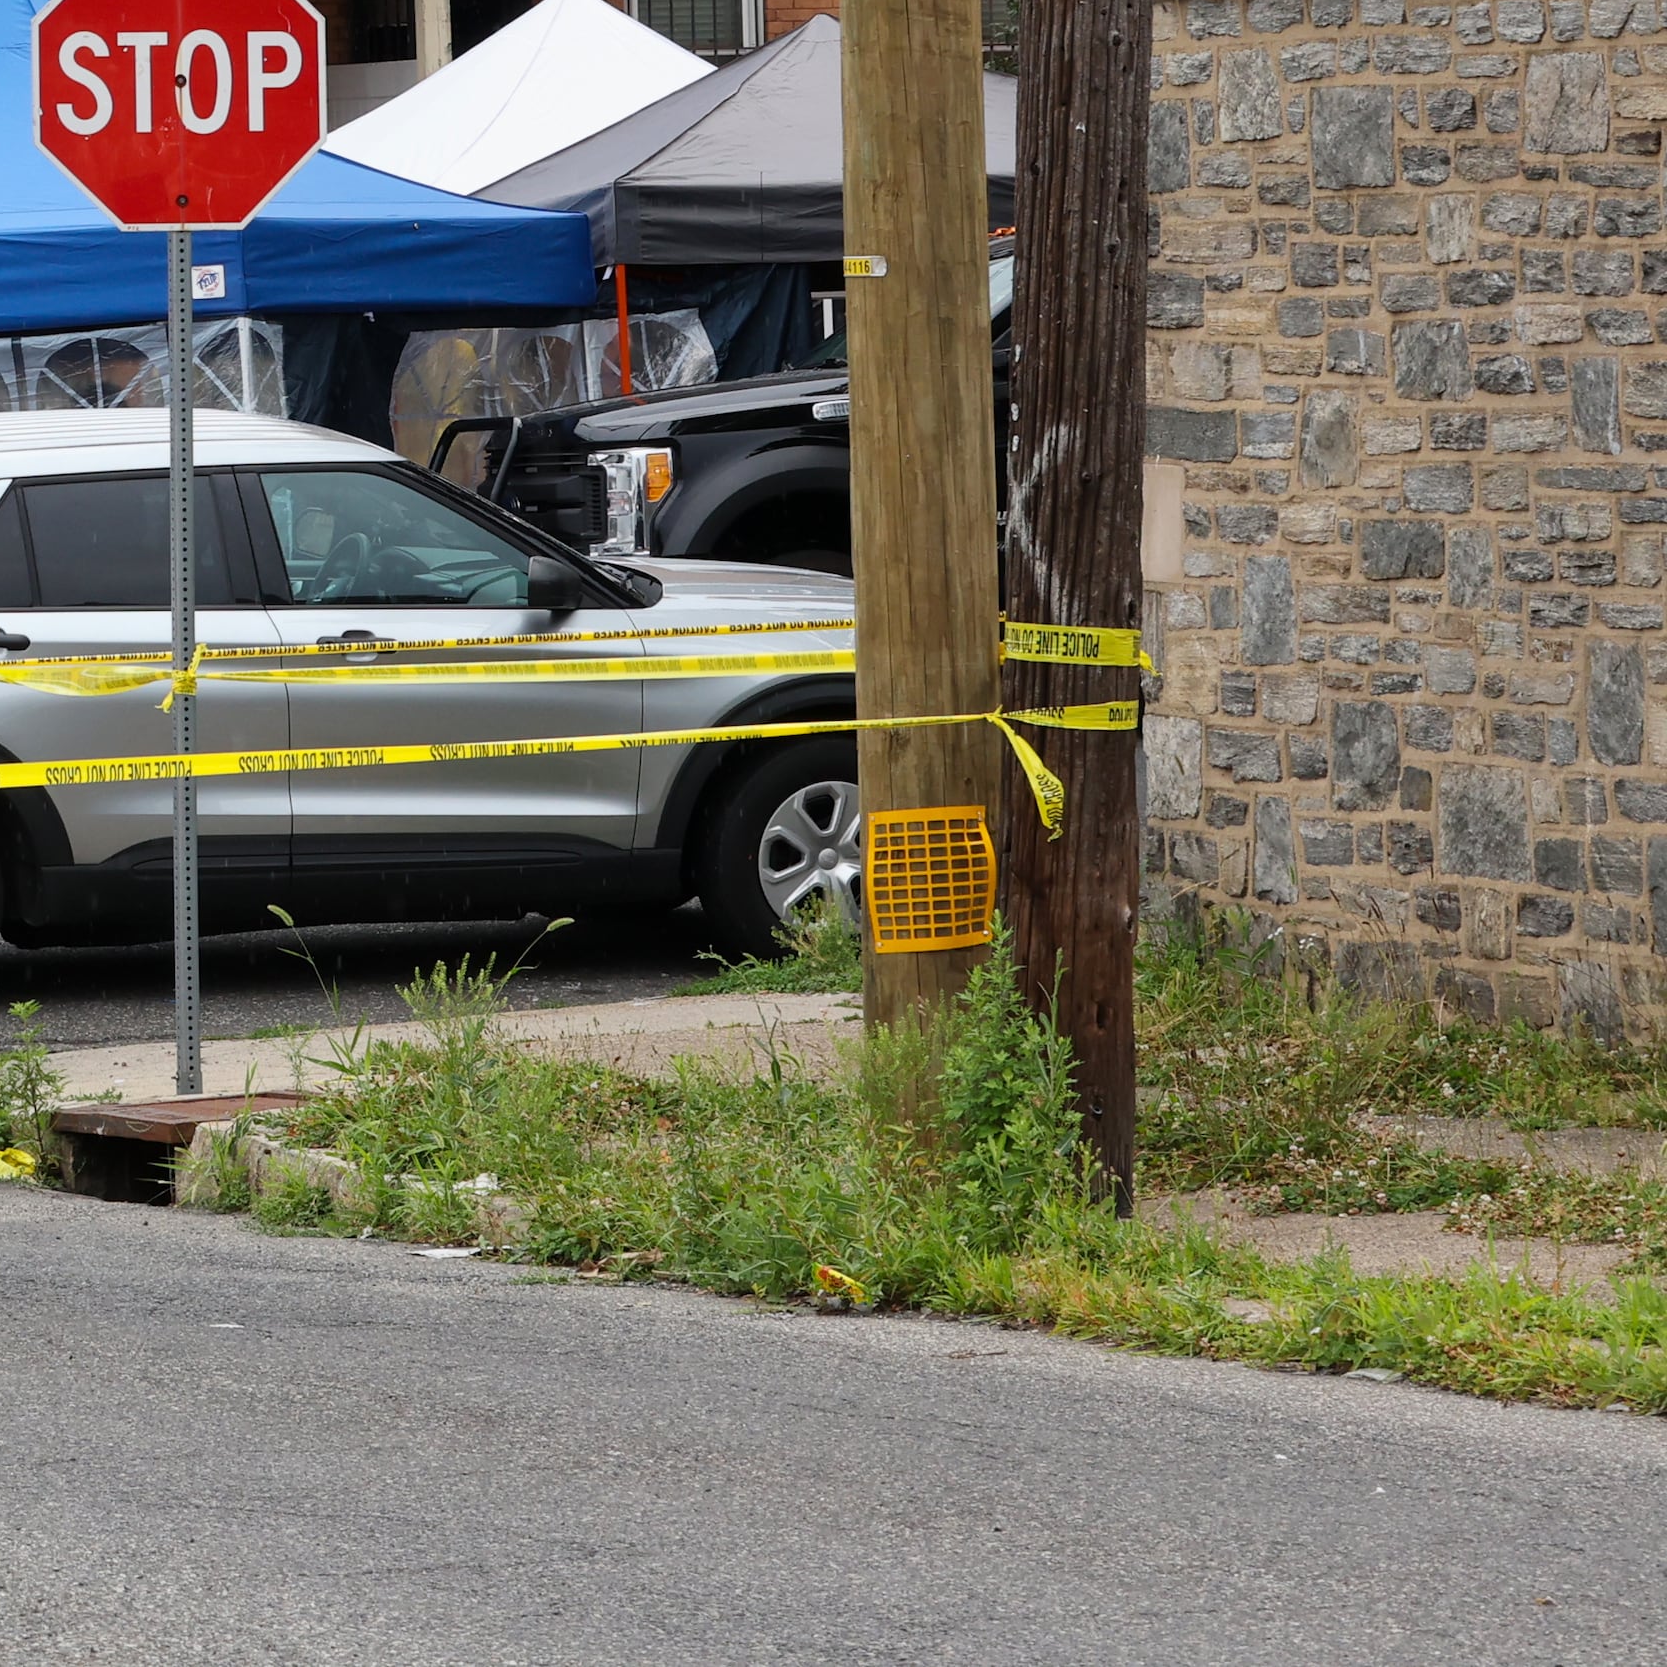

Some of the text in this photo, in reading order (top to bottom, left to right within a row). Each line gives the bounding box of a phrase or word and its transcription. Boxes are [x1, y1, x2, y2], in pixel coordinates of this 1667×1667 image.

[56, 28, 303, 135] STOP
[1035, 630, 1059, 656] LINE
[1063, 631, 1100, 658] POLICE
